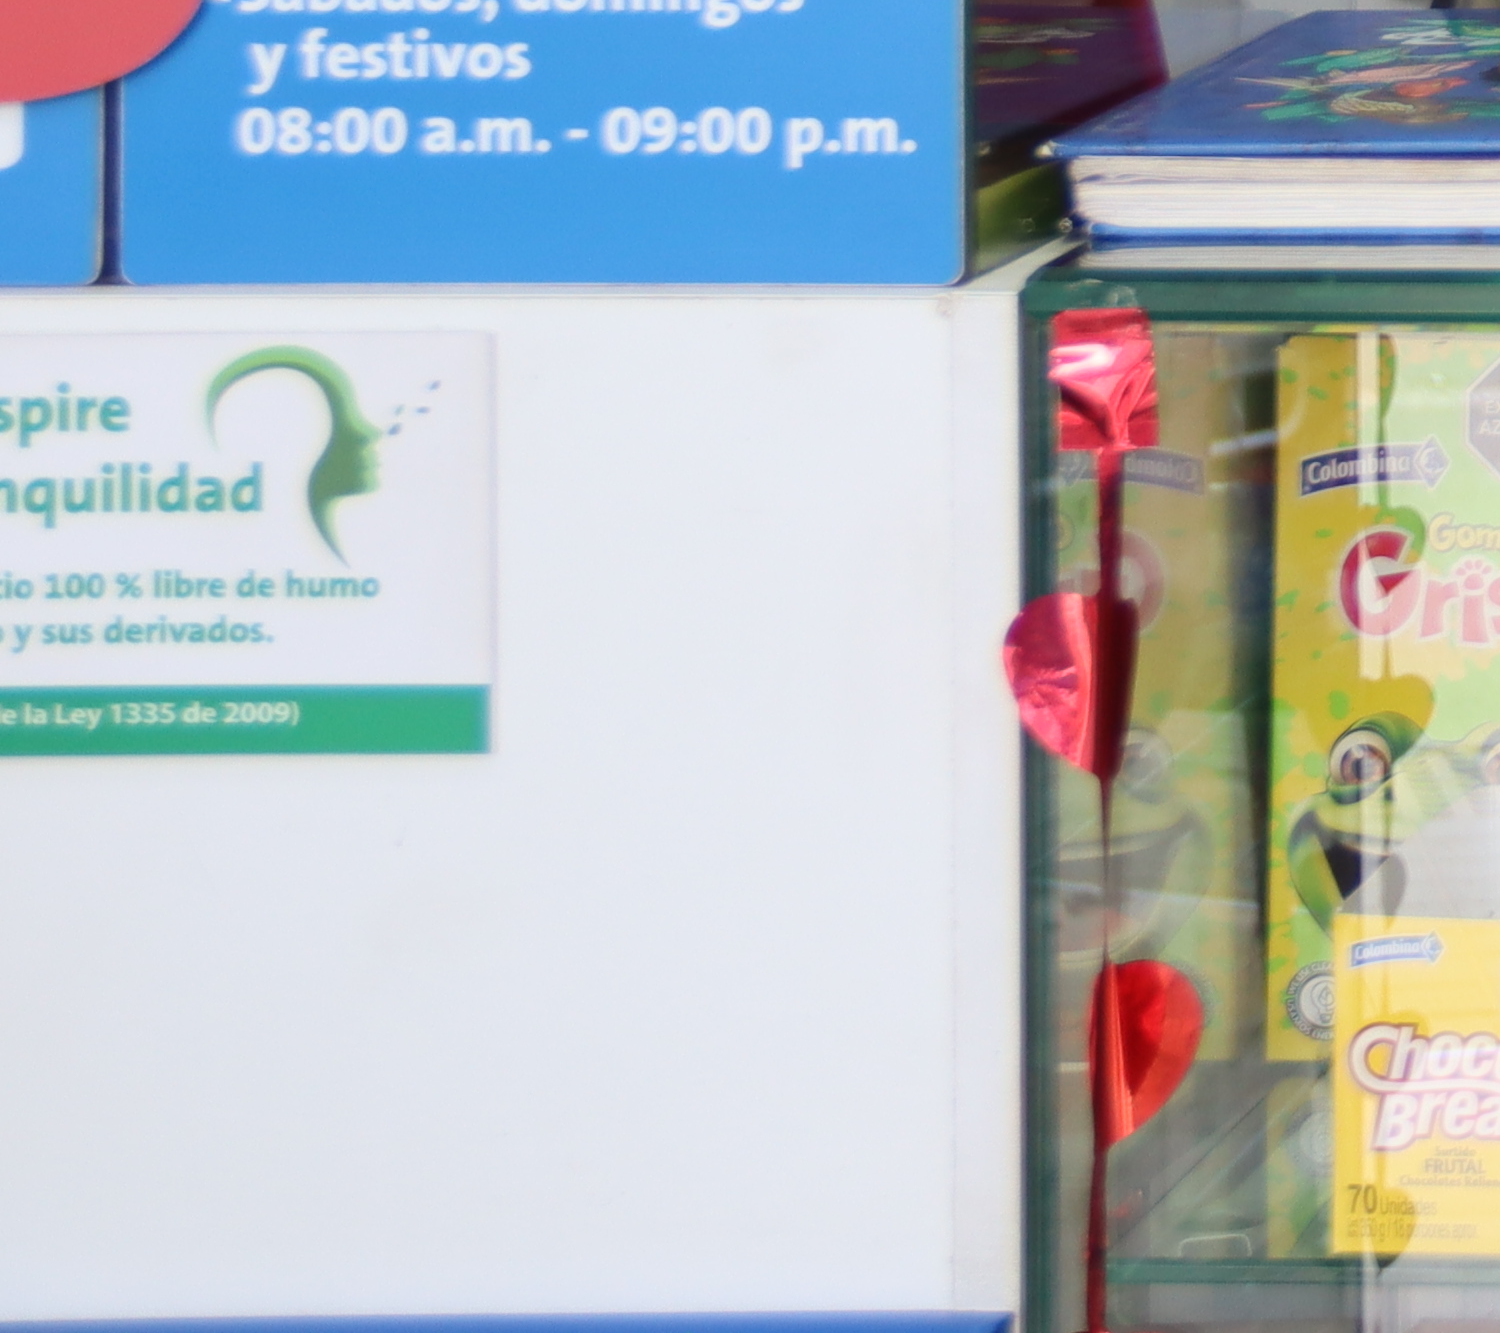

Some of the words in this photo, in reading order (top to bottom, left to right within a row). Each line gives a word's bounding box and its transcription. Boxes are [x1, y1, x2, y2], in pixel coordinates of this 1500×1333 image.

[248, 40, 287, 93] y
[298, 28, 532, 81] festivos
[236, 108, 407, 156] 08:00
[419, 114, 552, 156] a.m.
[606, 108, 773, 156] 09:00
[783, 116, 918, 171] p.m.
[45, 572, 106, 599] 100
[116, 572, 144, 599] %
[154, 569, 226, 599] libre
[236, 569, 275, 599] de
[286, 569, 380, 598] humo
[11, 622, 33, 655] y
[42, 622, 93, 644] sus
[102, 614, 275, 644] derivados.
[24, 701, 48, 725] la
[54, 702, 102, 730] Ley
[111, 702, 175, 725] 1335
[181, 701, 217, 725] de
[223, 701, 301, 727] 2009)
[1347, 1184, 1377, 1214] 70
[1379, 1198, 1437, 1216] Unidades
